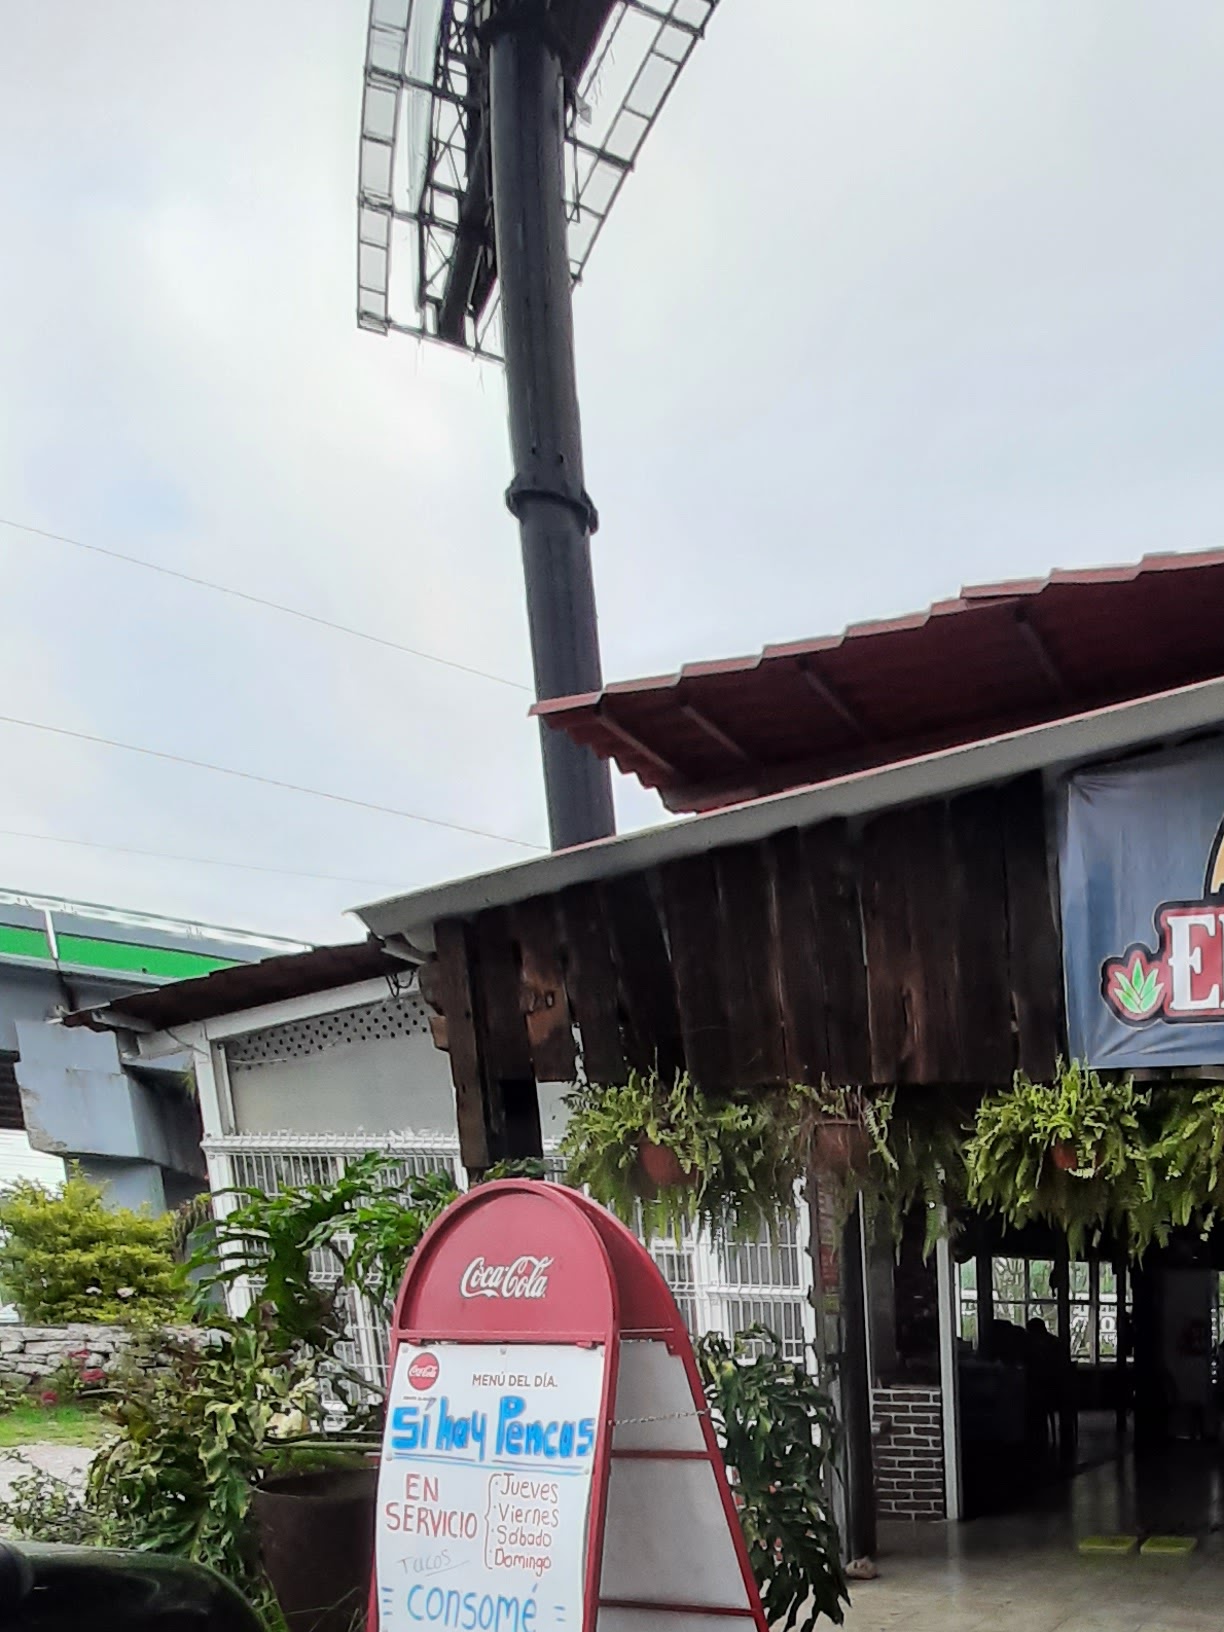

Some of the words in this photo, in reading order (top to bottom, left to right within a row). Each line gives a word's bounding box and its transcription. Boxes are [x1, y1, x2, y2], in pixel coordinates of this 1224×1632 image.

[461, 1255, 555, 1298] Coca-Cola
[472, 1372, 505, 1387] MENÚ
[508, 1375, 530, 1387] DEL
[435, 1396, 487, 1462] hay
[495, 1395, 596, 1459] Pencas
[406, 1474, 439, 1502] EN
[500, 1473, 559, 1504] Jueves
[385, 1502, 478, 1539] SERVICIO
[498, 1503, 559, 1527] Viernes
[495, 1548, 552, 1577] Domingo
